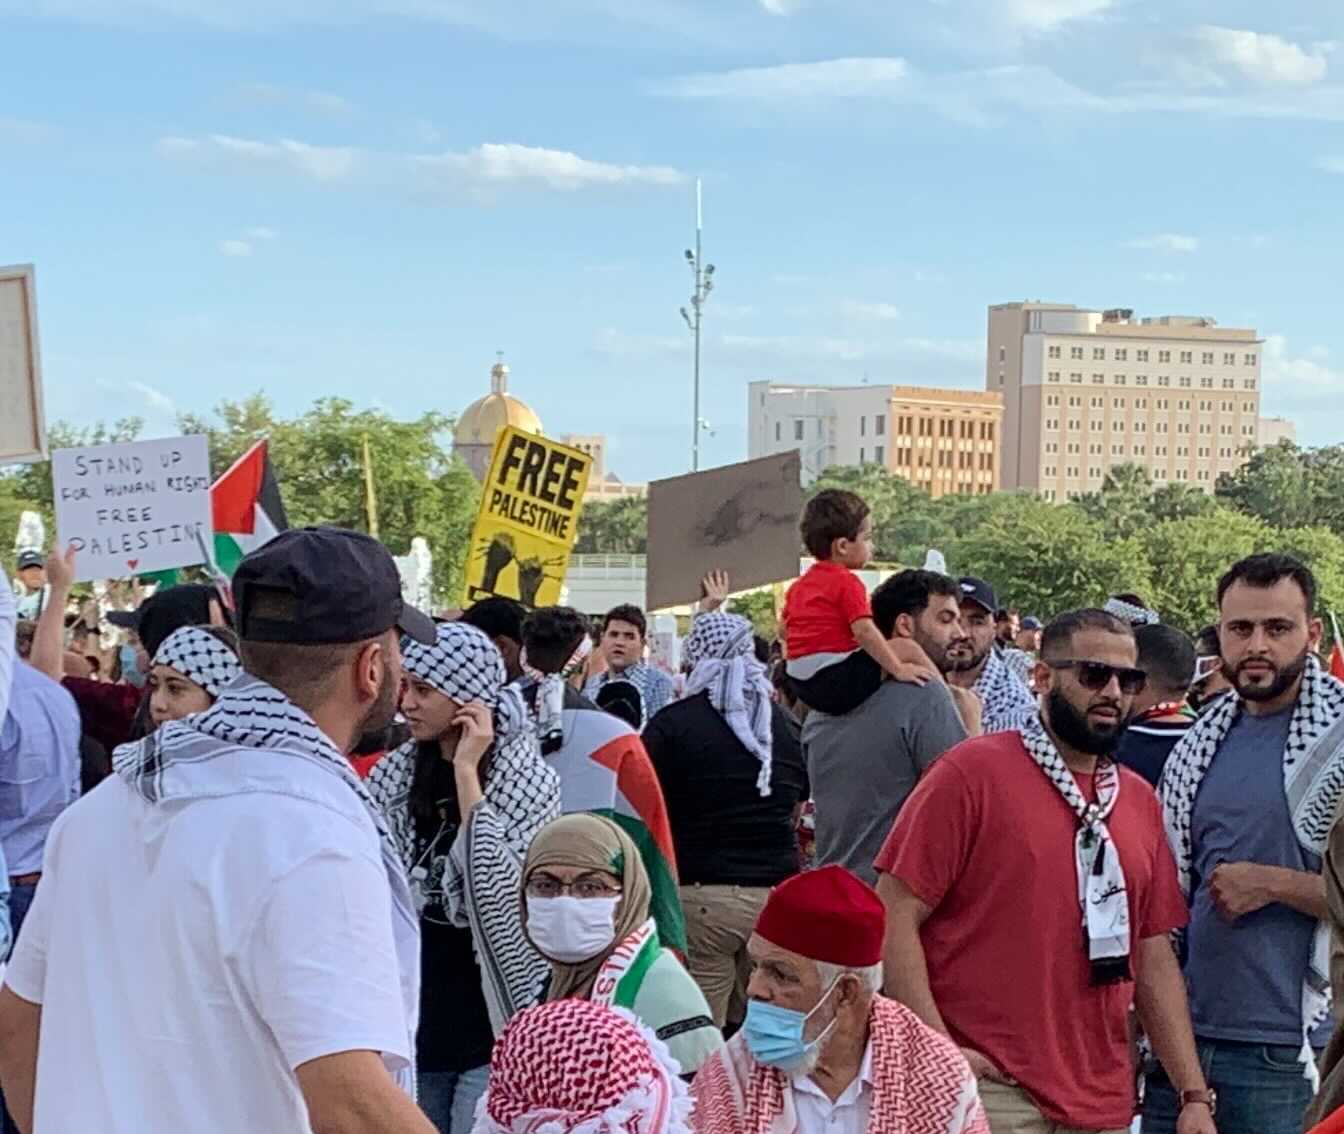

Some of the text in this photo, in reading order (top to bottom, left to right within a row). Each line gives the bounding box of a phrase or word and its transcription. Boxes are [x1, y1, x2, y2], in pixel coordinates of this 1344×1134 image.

[75, 451, 182, 477] STAND UP
[496, 433, 586, 511] FREE
[61, 487, 91, 501] FOR
[104, 480, 157, 497] HUMAN
[96, 506, 152, 525] FREE
[488, 488, 570, 540] PALESTINE
[68, 521, 203, 556] PALESTIN
